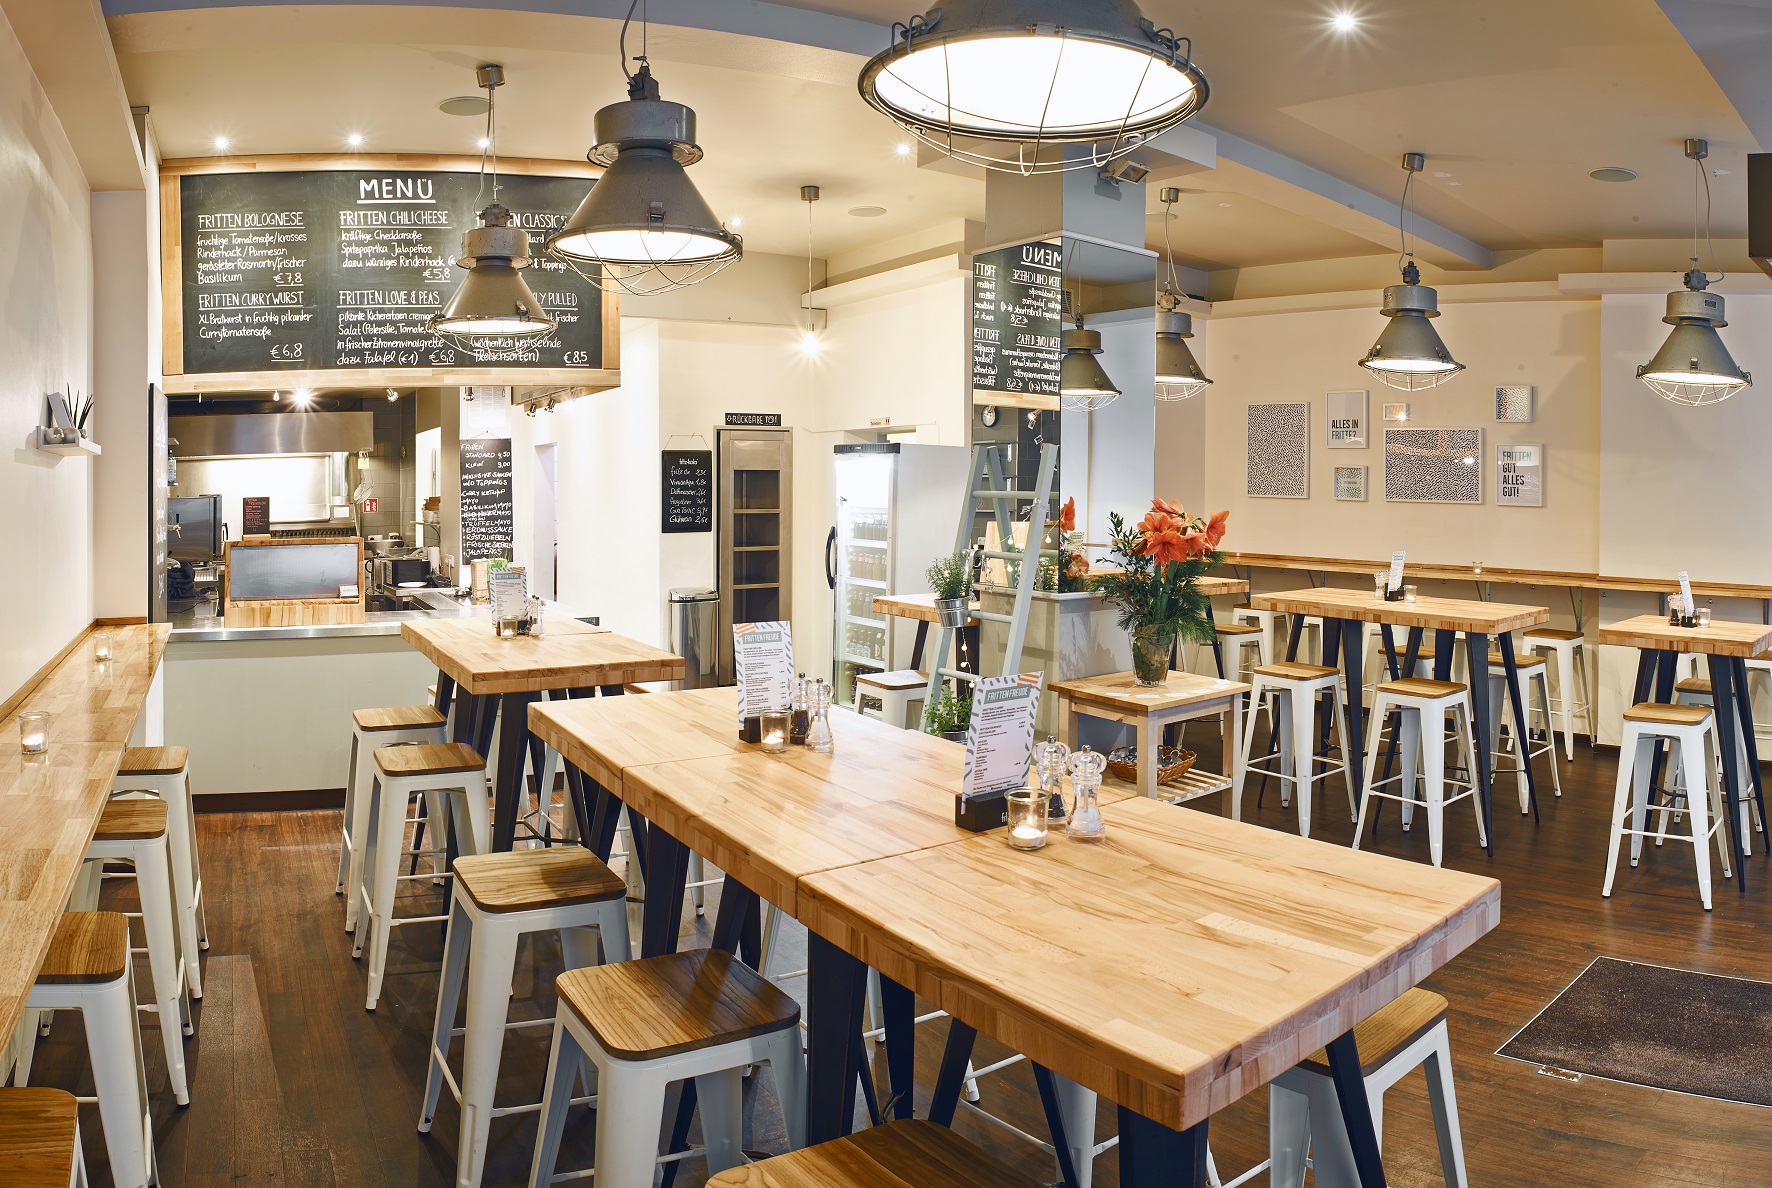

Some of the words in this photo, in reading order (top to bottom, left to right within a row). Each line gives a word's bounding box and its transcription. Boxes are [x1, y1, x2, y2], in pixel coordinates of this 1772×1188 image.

[360, 178, 433, 199] MENÜ
[198, 213, 242, 228] FRITTEN
[244, 212, 304, 228] BOLOGNESE
[339, 211, 387, 226] FRITTEN
[197, 234, 229, 247] fruchtige
[341, 230, 373, 243] kräftige
[391, 242, 433, 257] Jalapeños
[342, 258, 363, 267] dazu
[365, 257, 398, 270] würziges
[400, 255, 445, 267] Rinderhack
[197, 272, 243, 284] Basilikum
[198, 293, 240, 308] FRITTEN
[241, 291, 304, 306] CURRYWURST
[338, 290, 383, 305] FRITTEN
[385, 290, 409, 305] LOVE
[418, 290, 440, 305] PEAS
[548, 292, 578, 306] PULLED
[198, 314, 209, 324] XL
[209, 313, 242, 324] Bratwurst
[245, 314, 252, 323] in
[281, 310, 313, 325] pikanter
[338, 311, 365, 325] pikante
[555, 311, 580, 323] frischer
[199, 326, 272, 342] Currytomatensoße
[338, 325, 362, 335] Salat
[337, 353, 362, 365] dazu
[364, 351, 396, 365] Falafel
[732, 413, 764, 424] RÜCKGABE
[1331, 419, 1351, 429] ALLES
[1351, 419, 1359, 429] IN
[1331, 430, 1357, 440] FRITTE?
[1502, 451, 1532, 461] FRITTEN
[1502, 462, 1516, 473] GUT
[1502, 475, 1525, 485] ALLES
[1502, 486, 1519, 497] GUT!
